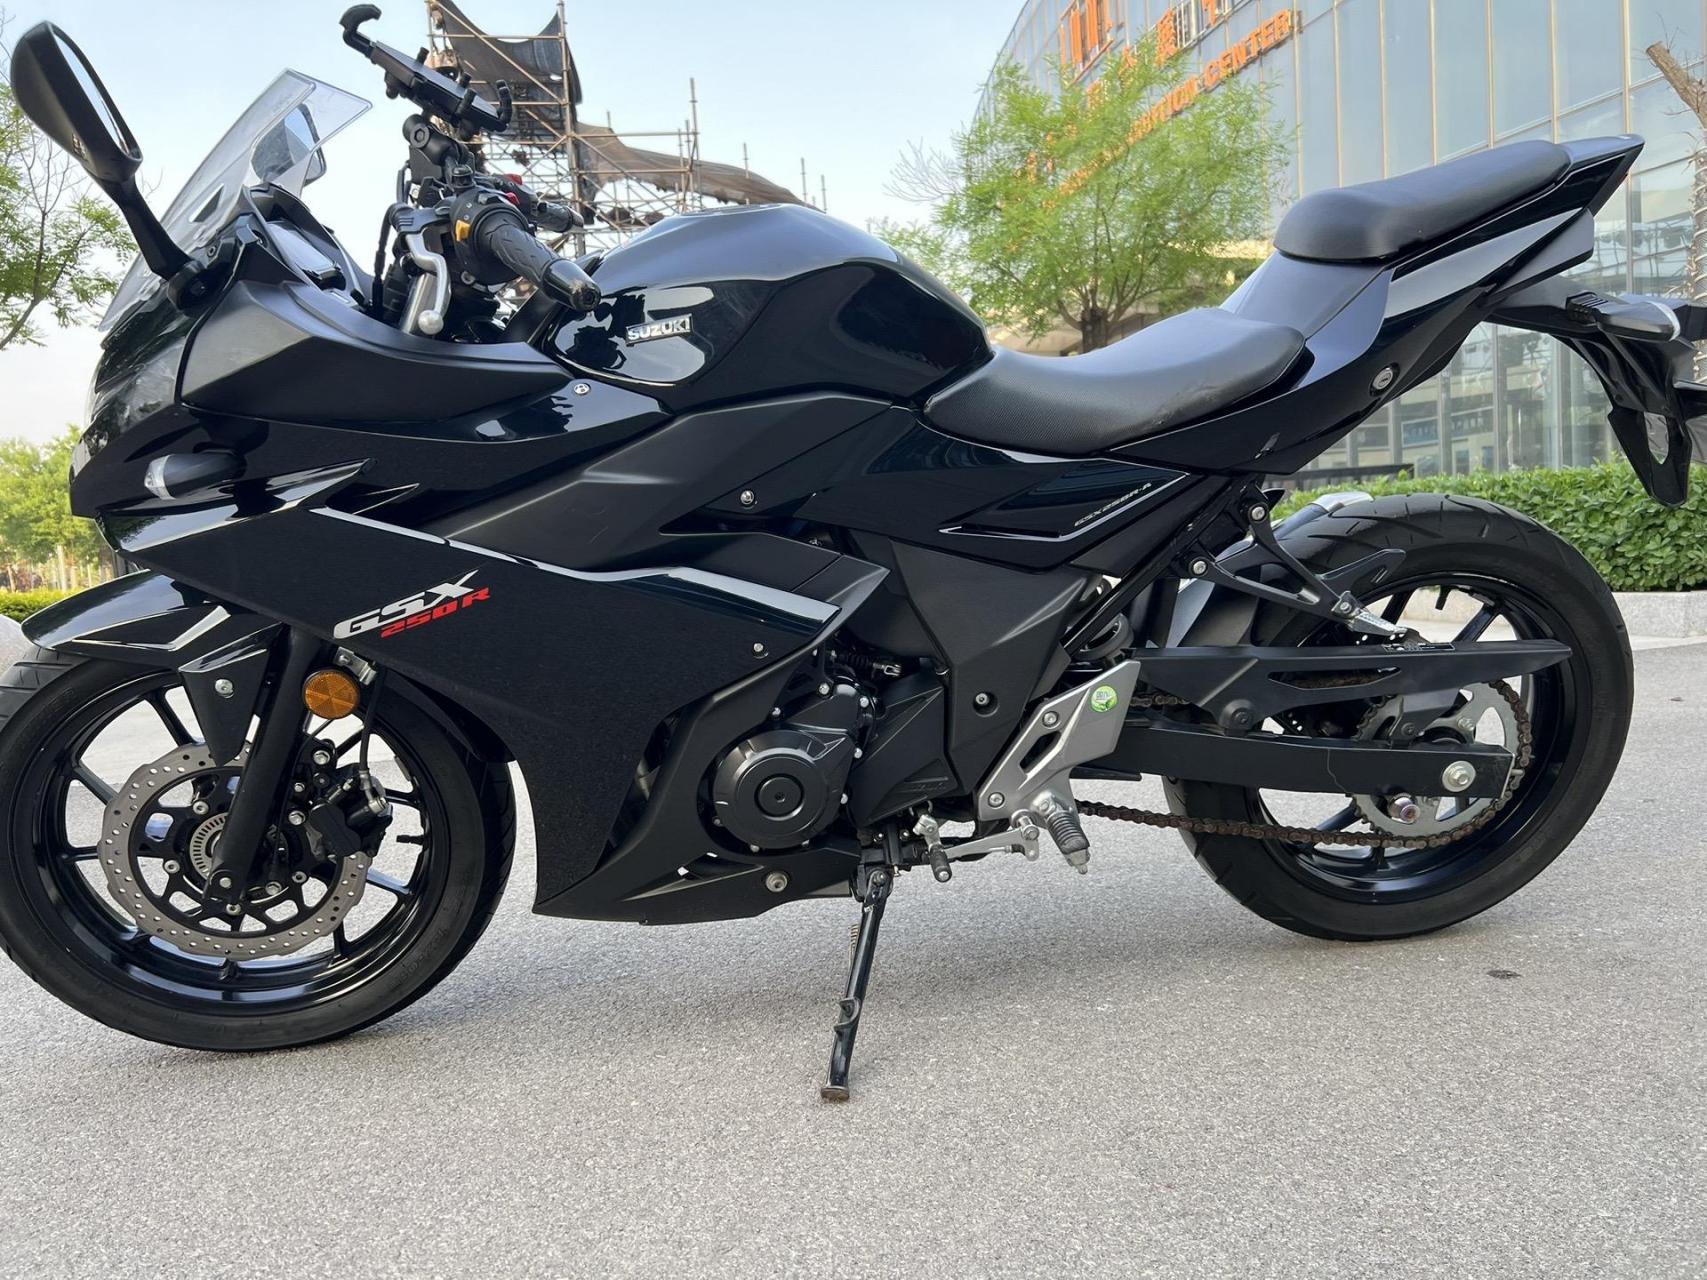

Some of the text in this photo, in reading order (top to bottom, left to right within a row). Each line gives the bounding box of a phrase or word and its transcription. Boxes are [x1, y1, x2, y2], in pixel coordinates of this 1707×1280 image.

[1203, 9, 1292, 88] CENTER
[627, 318, 691, 340] SUZUKI
[333, 569, 479, 639] GSX
